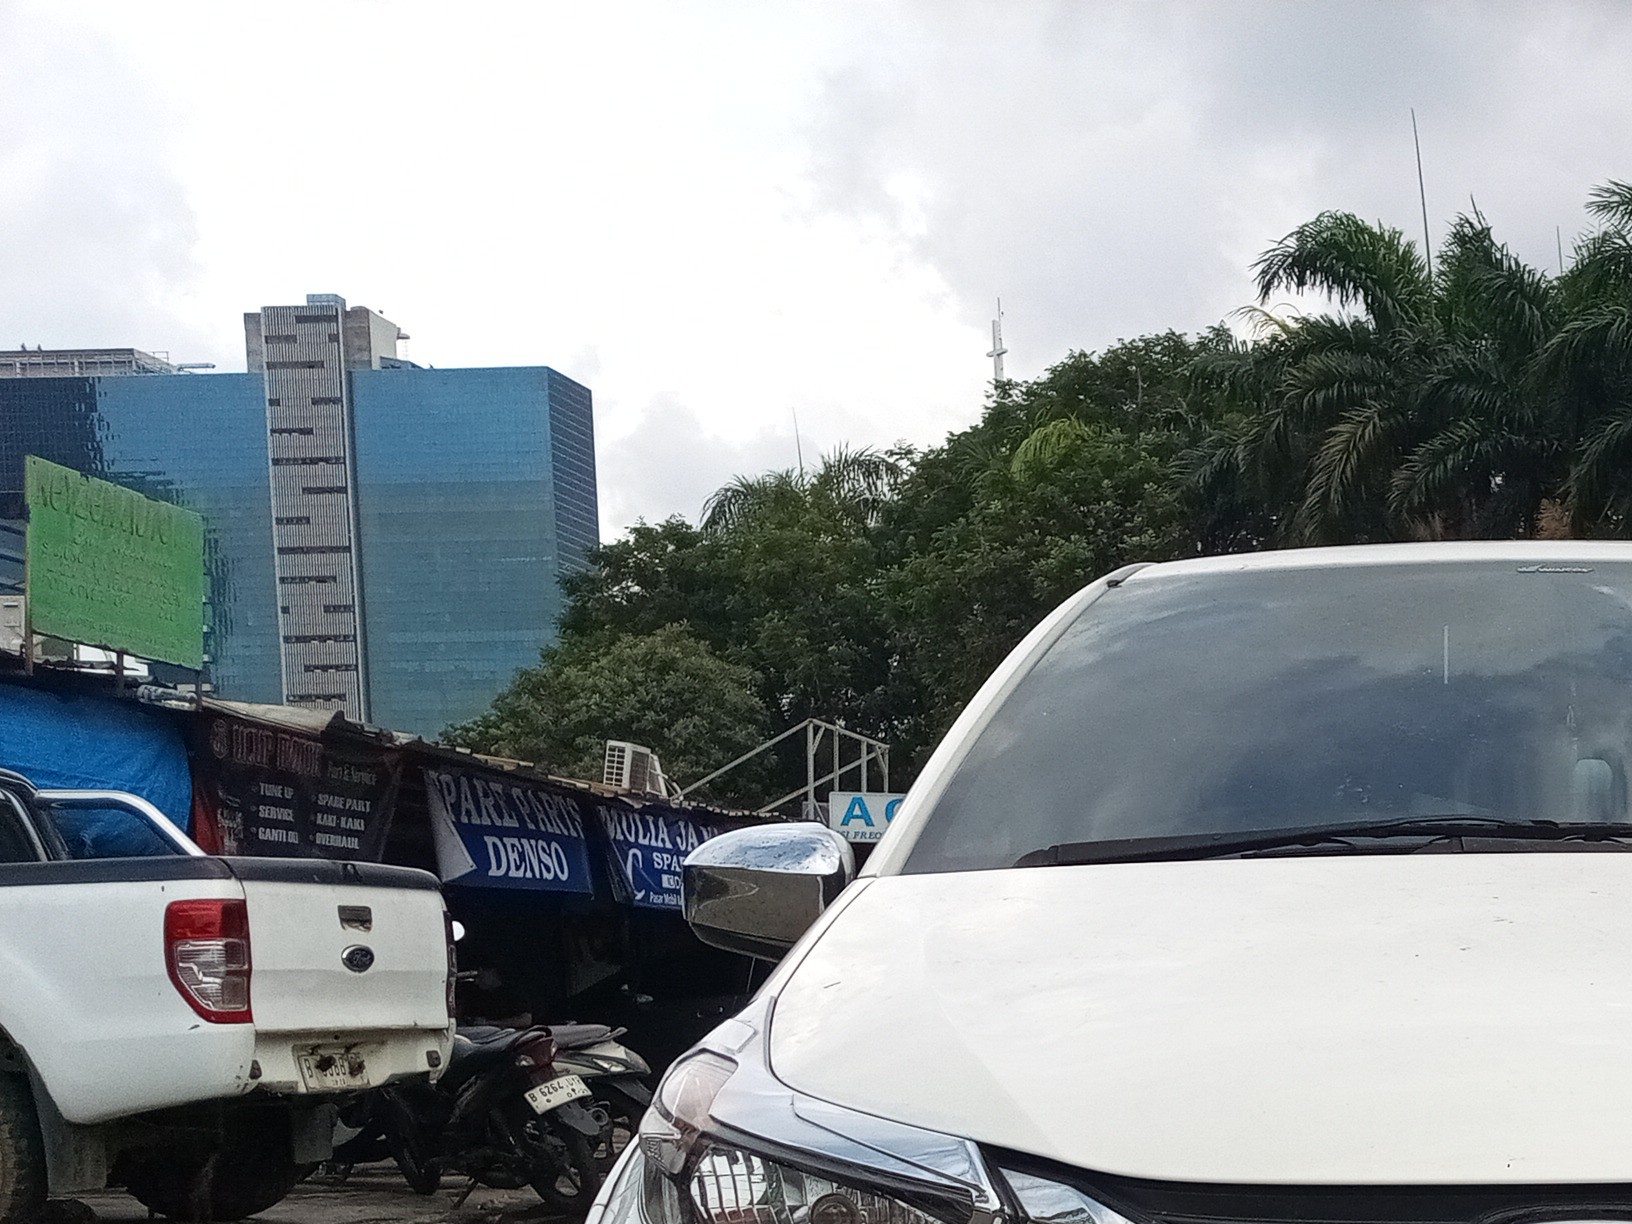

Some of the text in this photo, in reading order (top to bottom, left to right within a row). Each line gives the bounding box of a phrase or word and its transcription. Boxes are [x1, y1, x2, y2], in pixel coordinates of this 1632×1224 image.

[258, 805, 295, 823] SERVICE
[317, 793, 372, 814] SPARE PART
[430, 771, 519, 828] PARE
[597, 804, 674, 850] MULIA
[483, 835, 570, 882] DENSO
[528, 1092, 538, 1103] B
